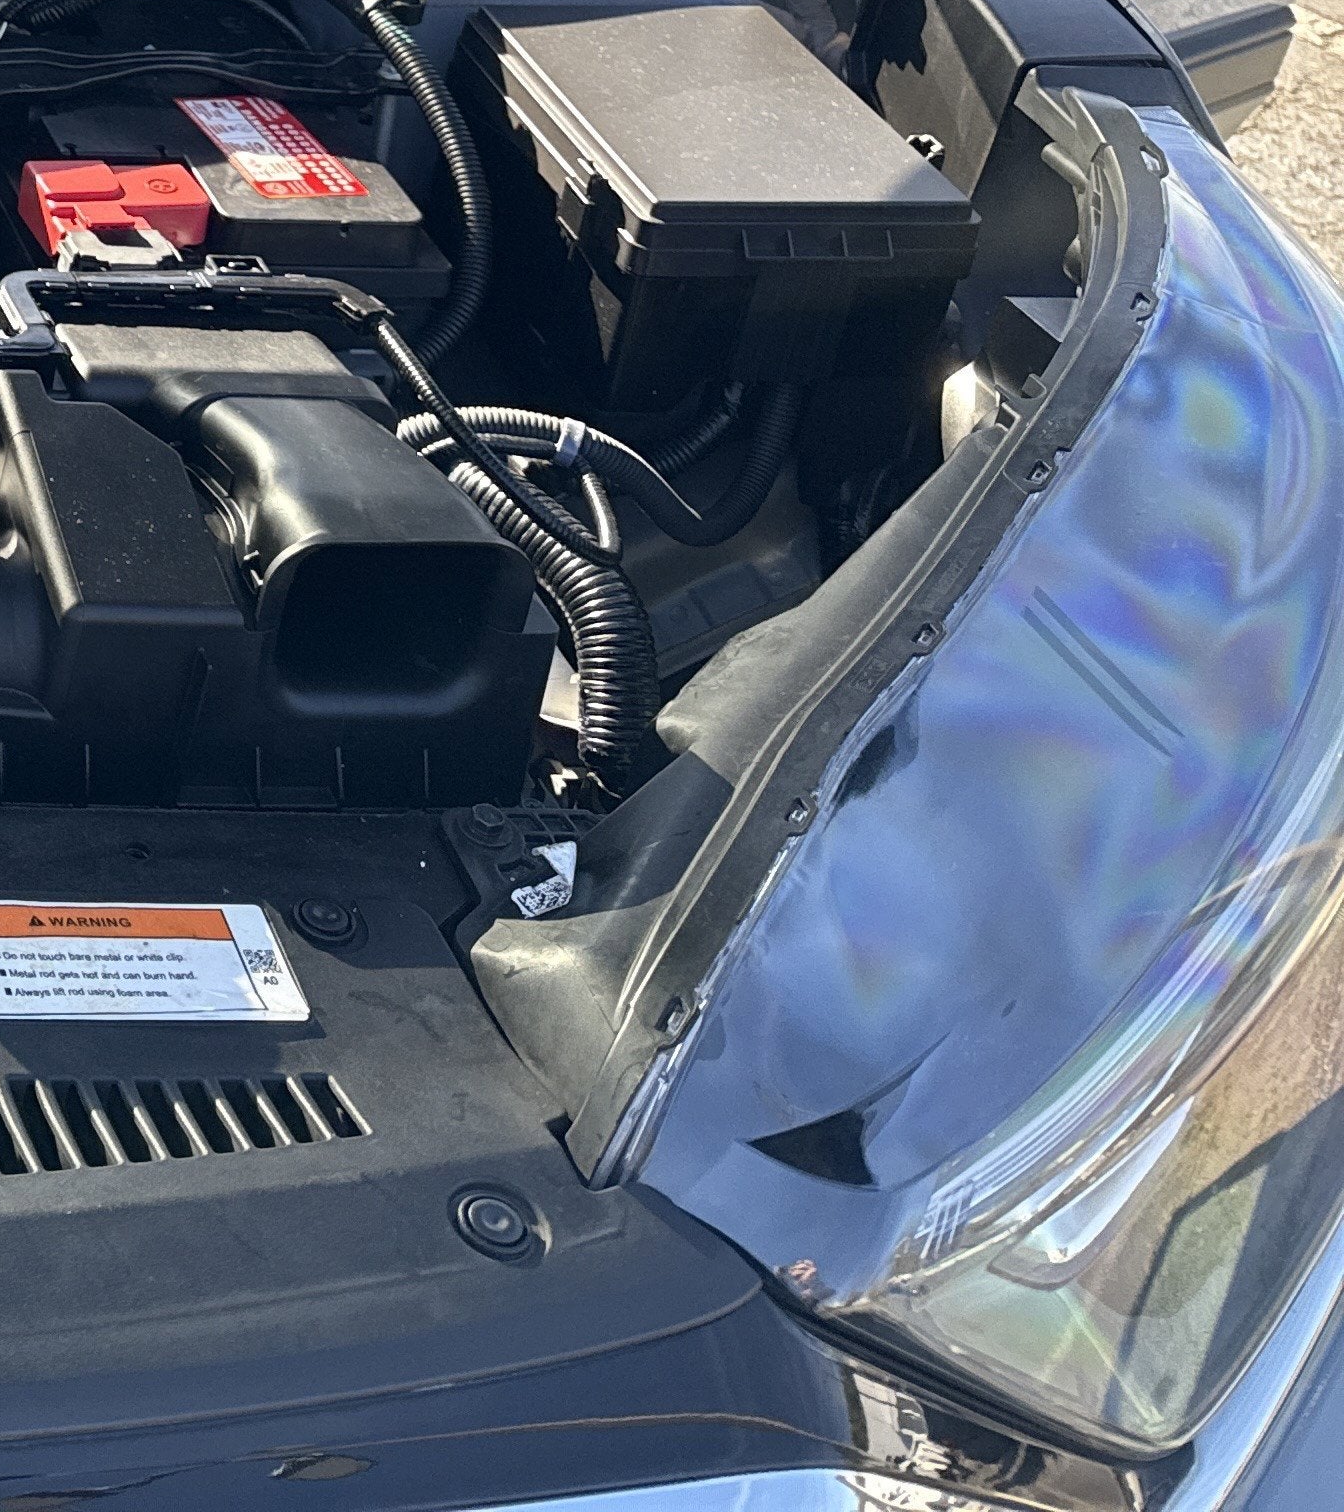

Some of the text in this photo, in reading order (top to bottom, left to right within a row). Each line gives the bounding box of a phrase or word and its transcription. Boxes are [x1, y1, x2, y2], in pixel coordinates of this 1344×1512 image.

[48, 916, 132, 928] WARNING
[2, 951, 18, 960] Do
[20, 951, 37, 960] not
[38, 951, 67, 961] touch
[68, 952, 92, 961] bare
[93, 953, 122, 962] metal
[124, 954, 134, 962] or
[8, 968, 37, 978] Metal
[39, 970, 56, 979] rod
[58, 971, 80, 980] gets
[81, 970, 100, 979] hot
[101, 971, 121, 980] and
[122, 972, 142, 980] can
[143, 971, 167, 980] burn
[15, 987, 52, 999] Always
[53, 987, 67, 997] lift
[68, 987, 86, 997] rod
[87, 988, 116, 999] using
[116, 988, 144, 997] foam
